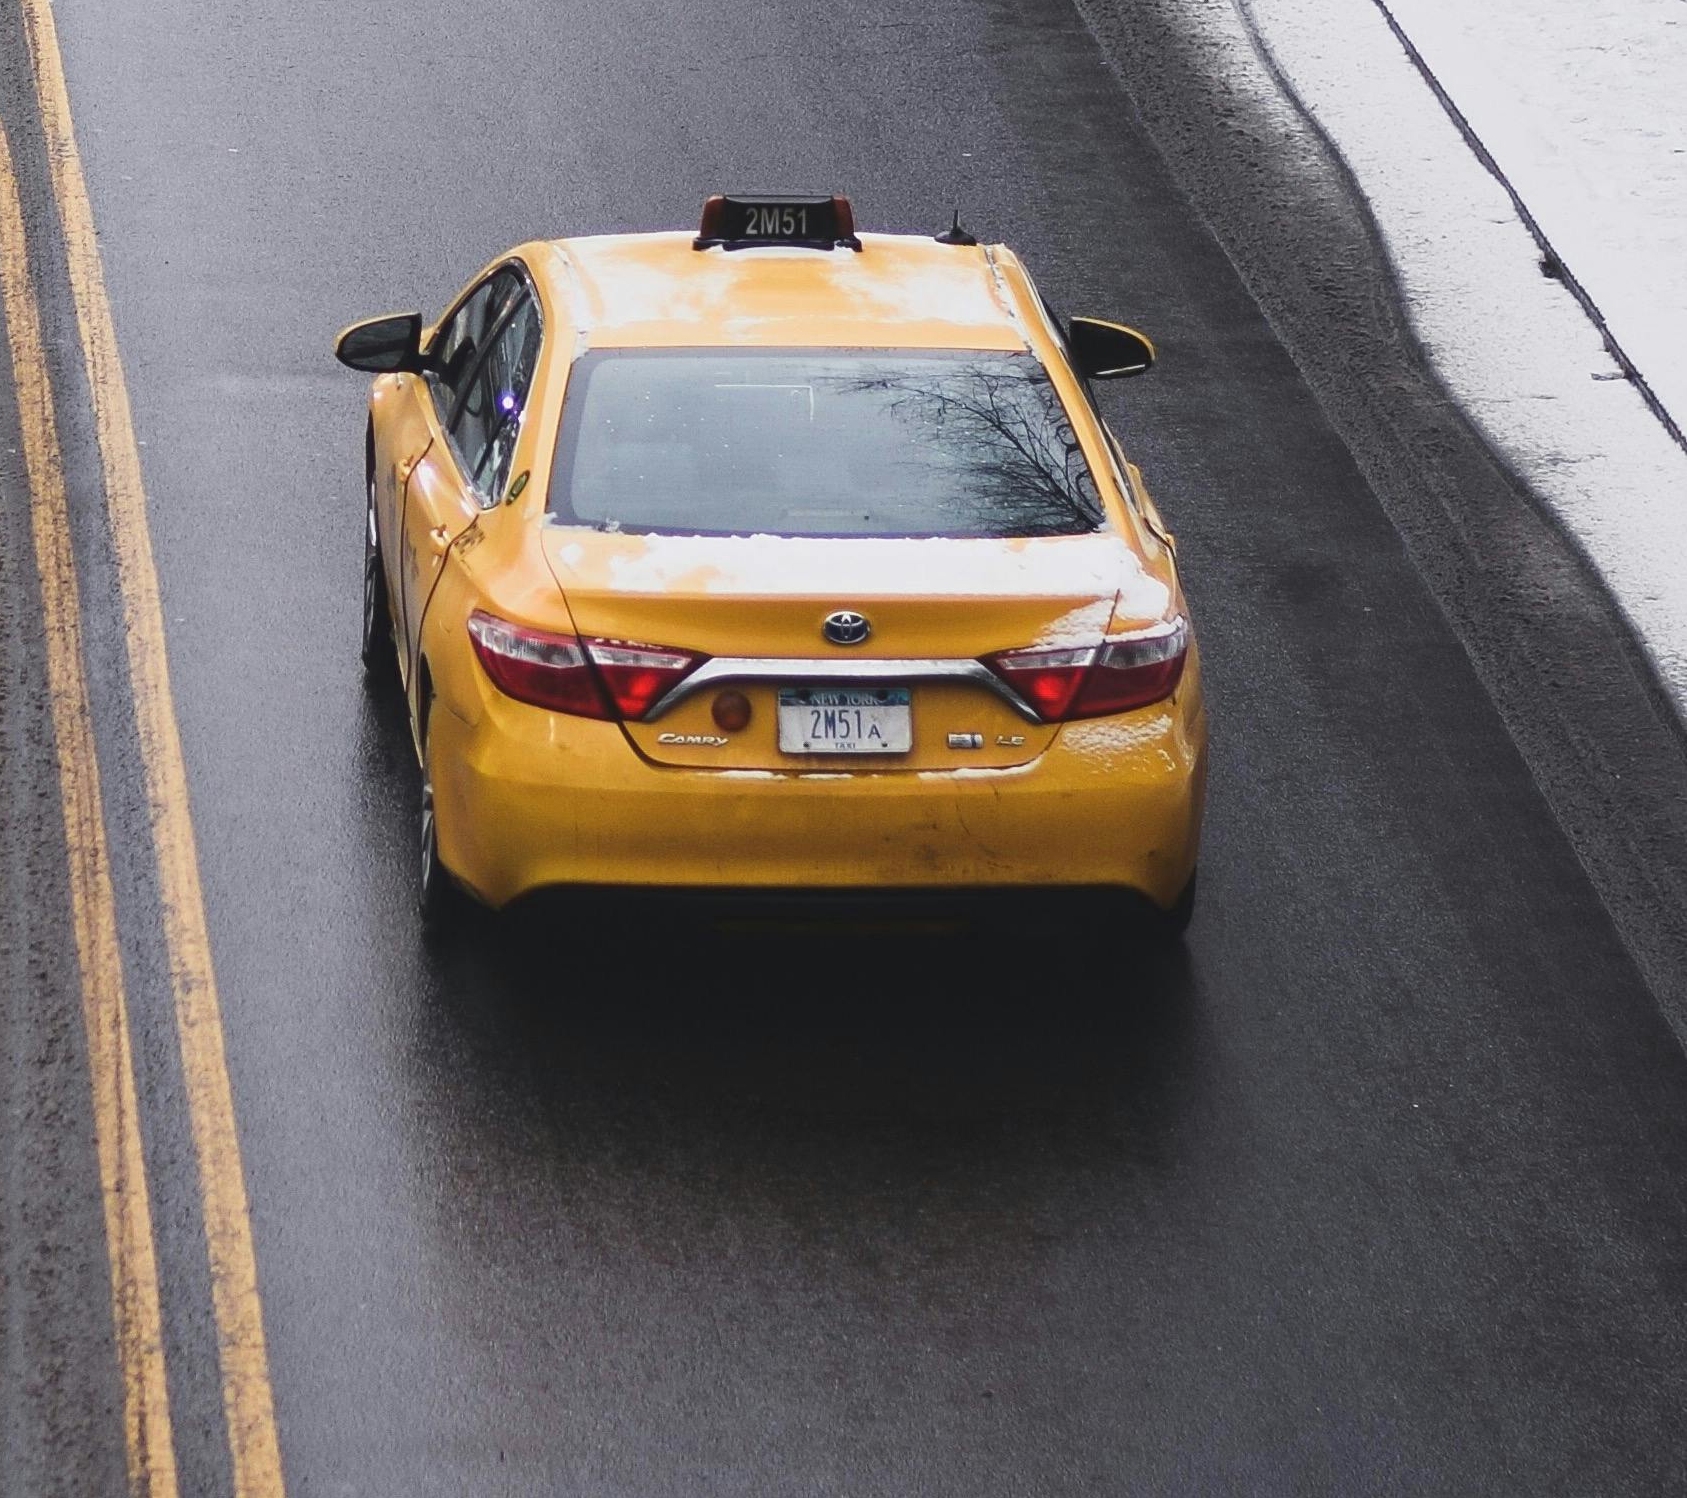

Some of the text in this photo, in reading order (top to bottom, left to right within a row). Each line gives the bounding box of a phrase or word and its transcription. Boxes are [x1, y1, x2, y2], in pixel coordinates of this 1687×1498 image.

[745, 207, 806, 235] 2M51
[810, 692, 878, 705] NEW YORK
[996, 735, 1026, 746] LE
